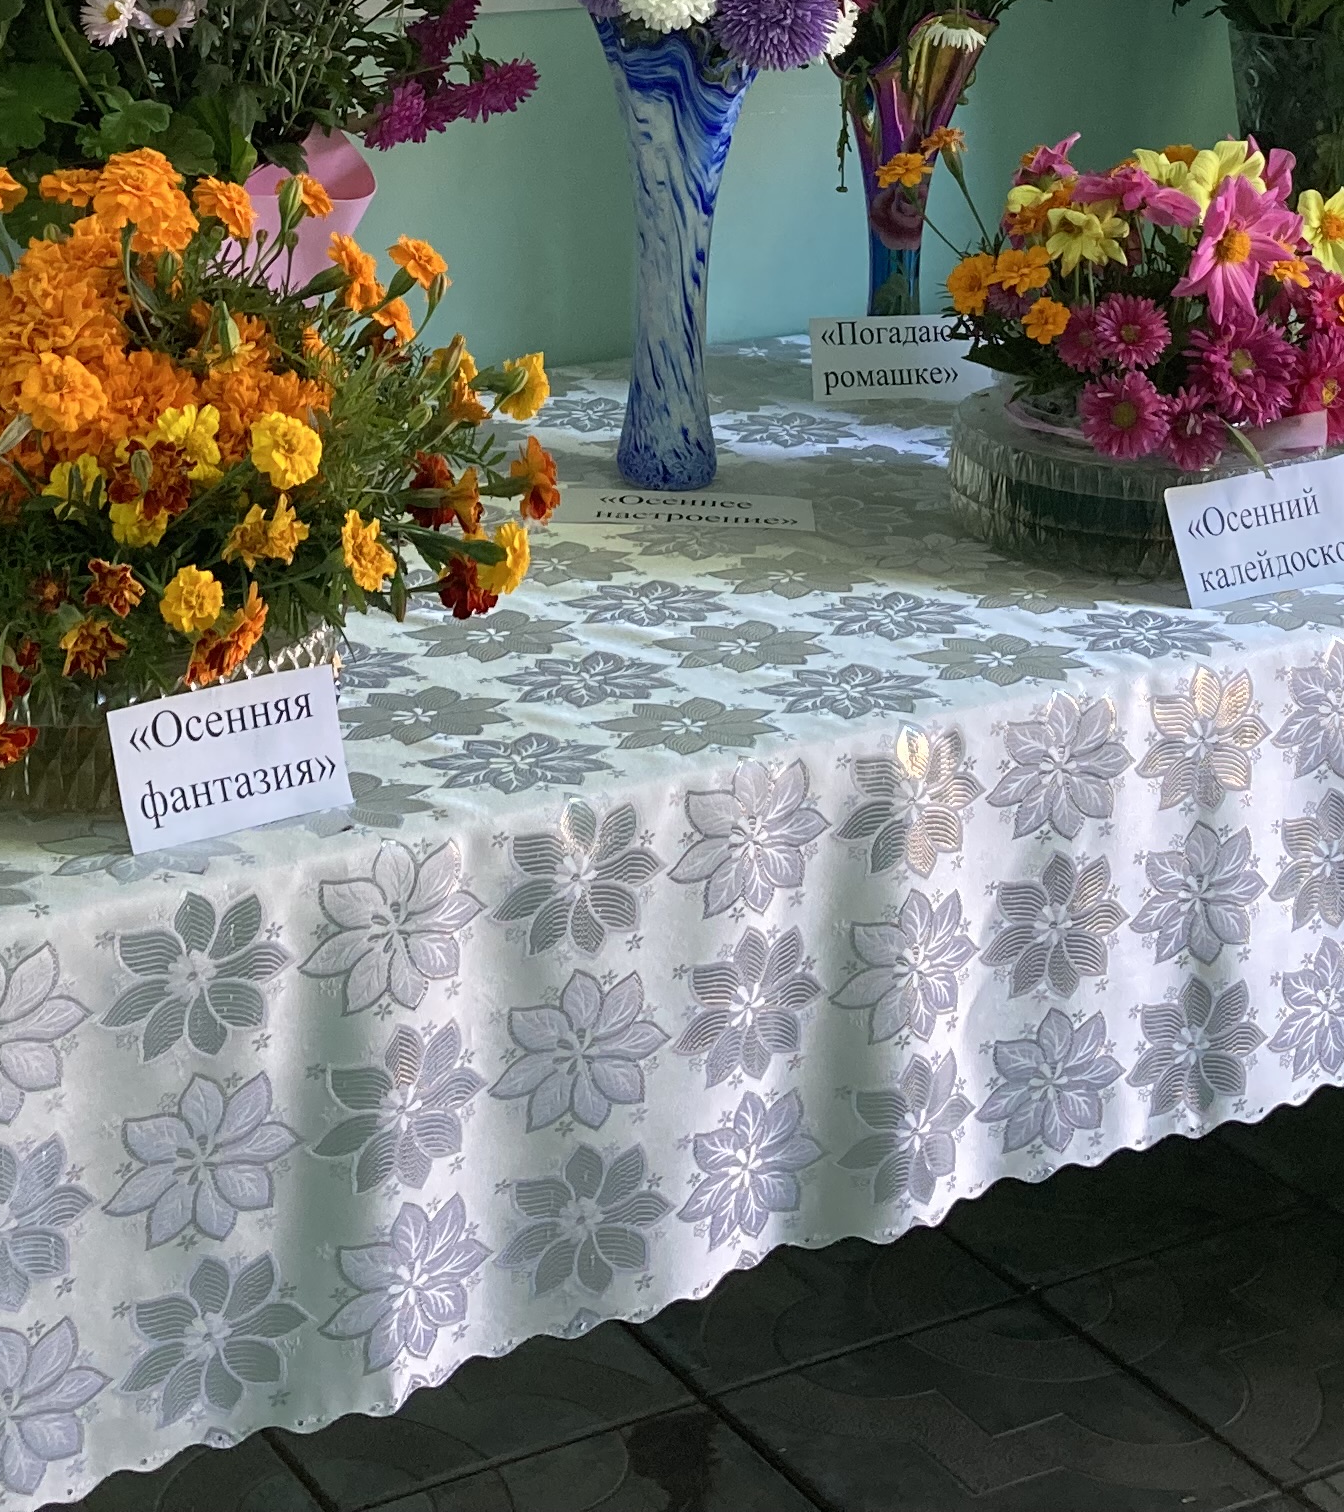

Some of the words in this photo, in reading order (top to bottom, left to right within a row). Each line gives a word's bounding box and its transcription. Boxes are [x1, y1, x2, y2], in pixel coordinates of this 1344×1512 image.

[823, 366, 959, 396] ромашке»
[595, 509, 799, 526] настроение»
[599, 494, 753, 510] «Осеннее
[1187, 487, 1321, 540] «Осенний
[129, 692, 315, 753] «Осенняя
[140, 755, 337, 829] фантазия»
